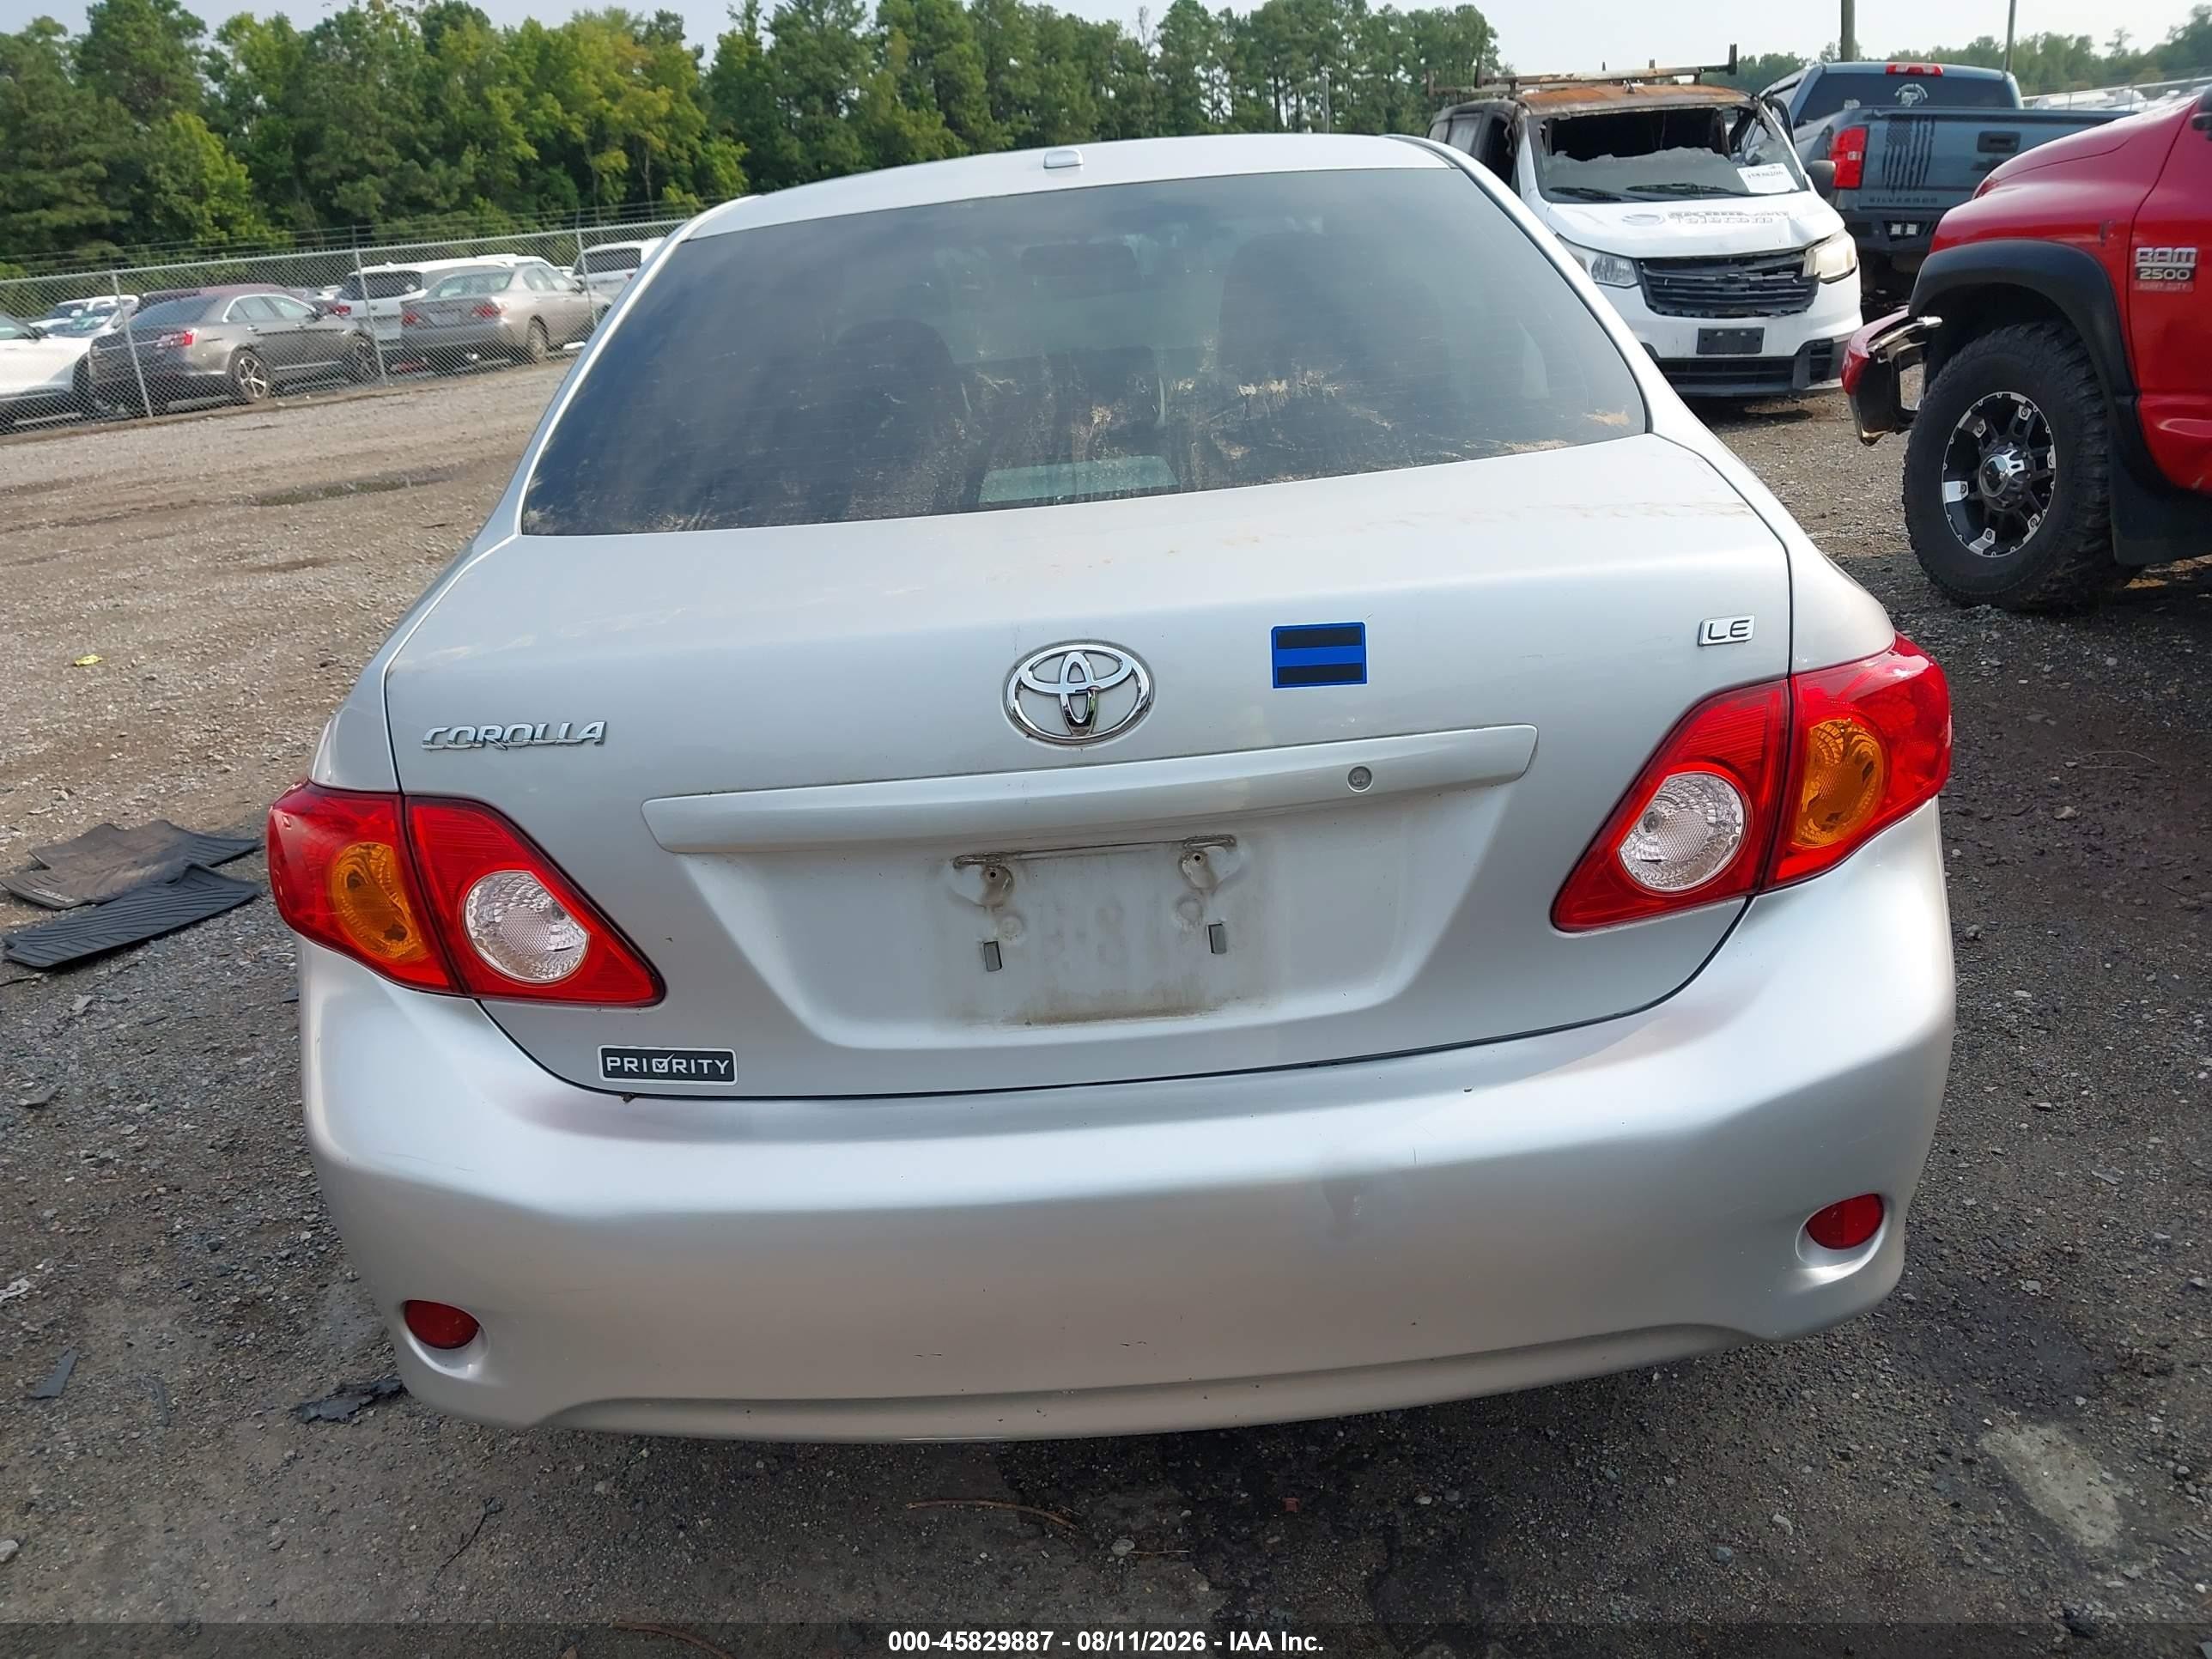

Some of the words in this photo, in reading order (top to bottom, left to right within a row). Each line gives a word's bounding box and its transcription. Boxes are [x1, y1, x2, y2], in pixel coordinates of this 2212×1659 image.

[2135, 246, 2197, 266] RAM
[2139, 267, 2191, 281] 2500
[1707, 618, 1751, 641] LE
[421, 720, 608, 750] COROLLA
[605, 1054, 730, 1075] PRIORITY
